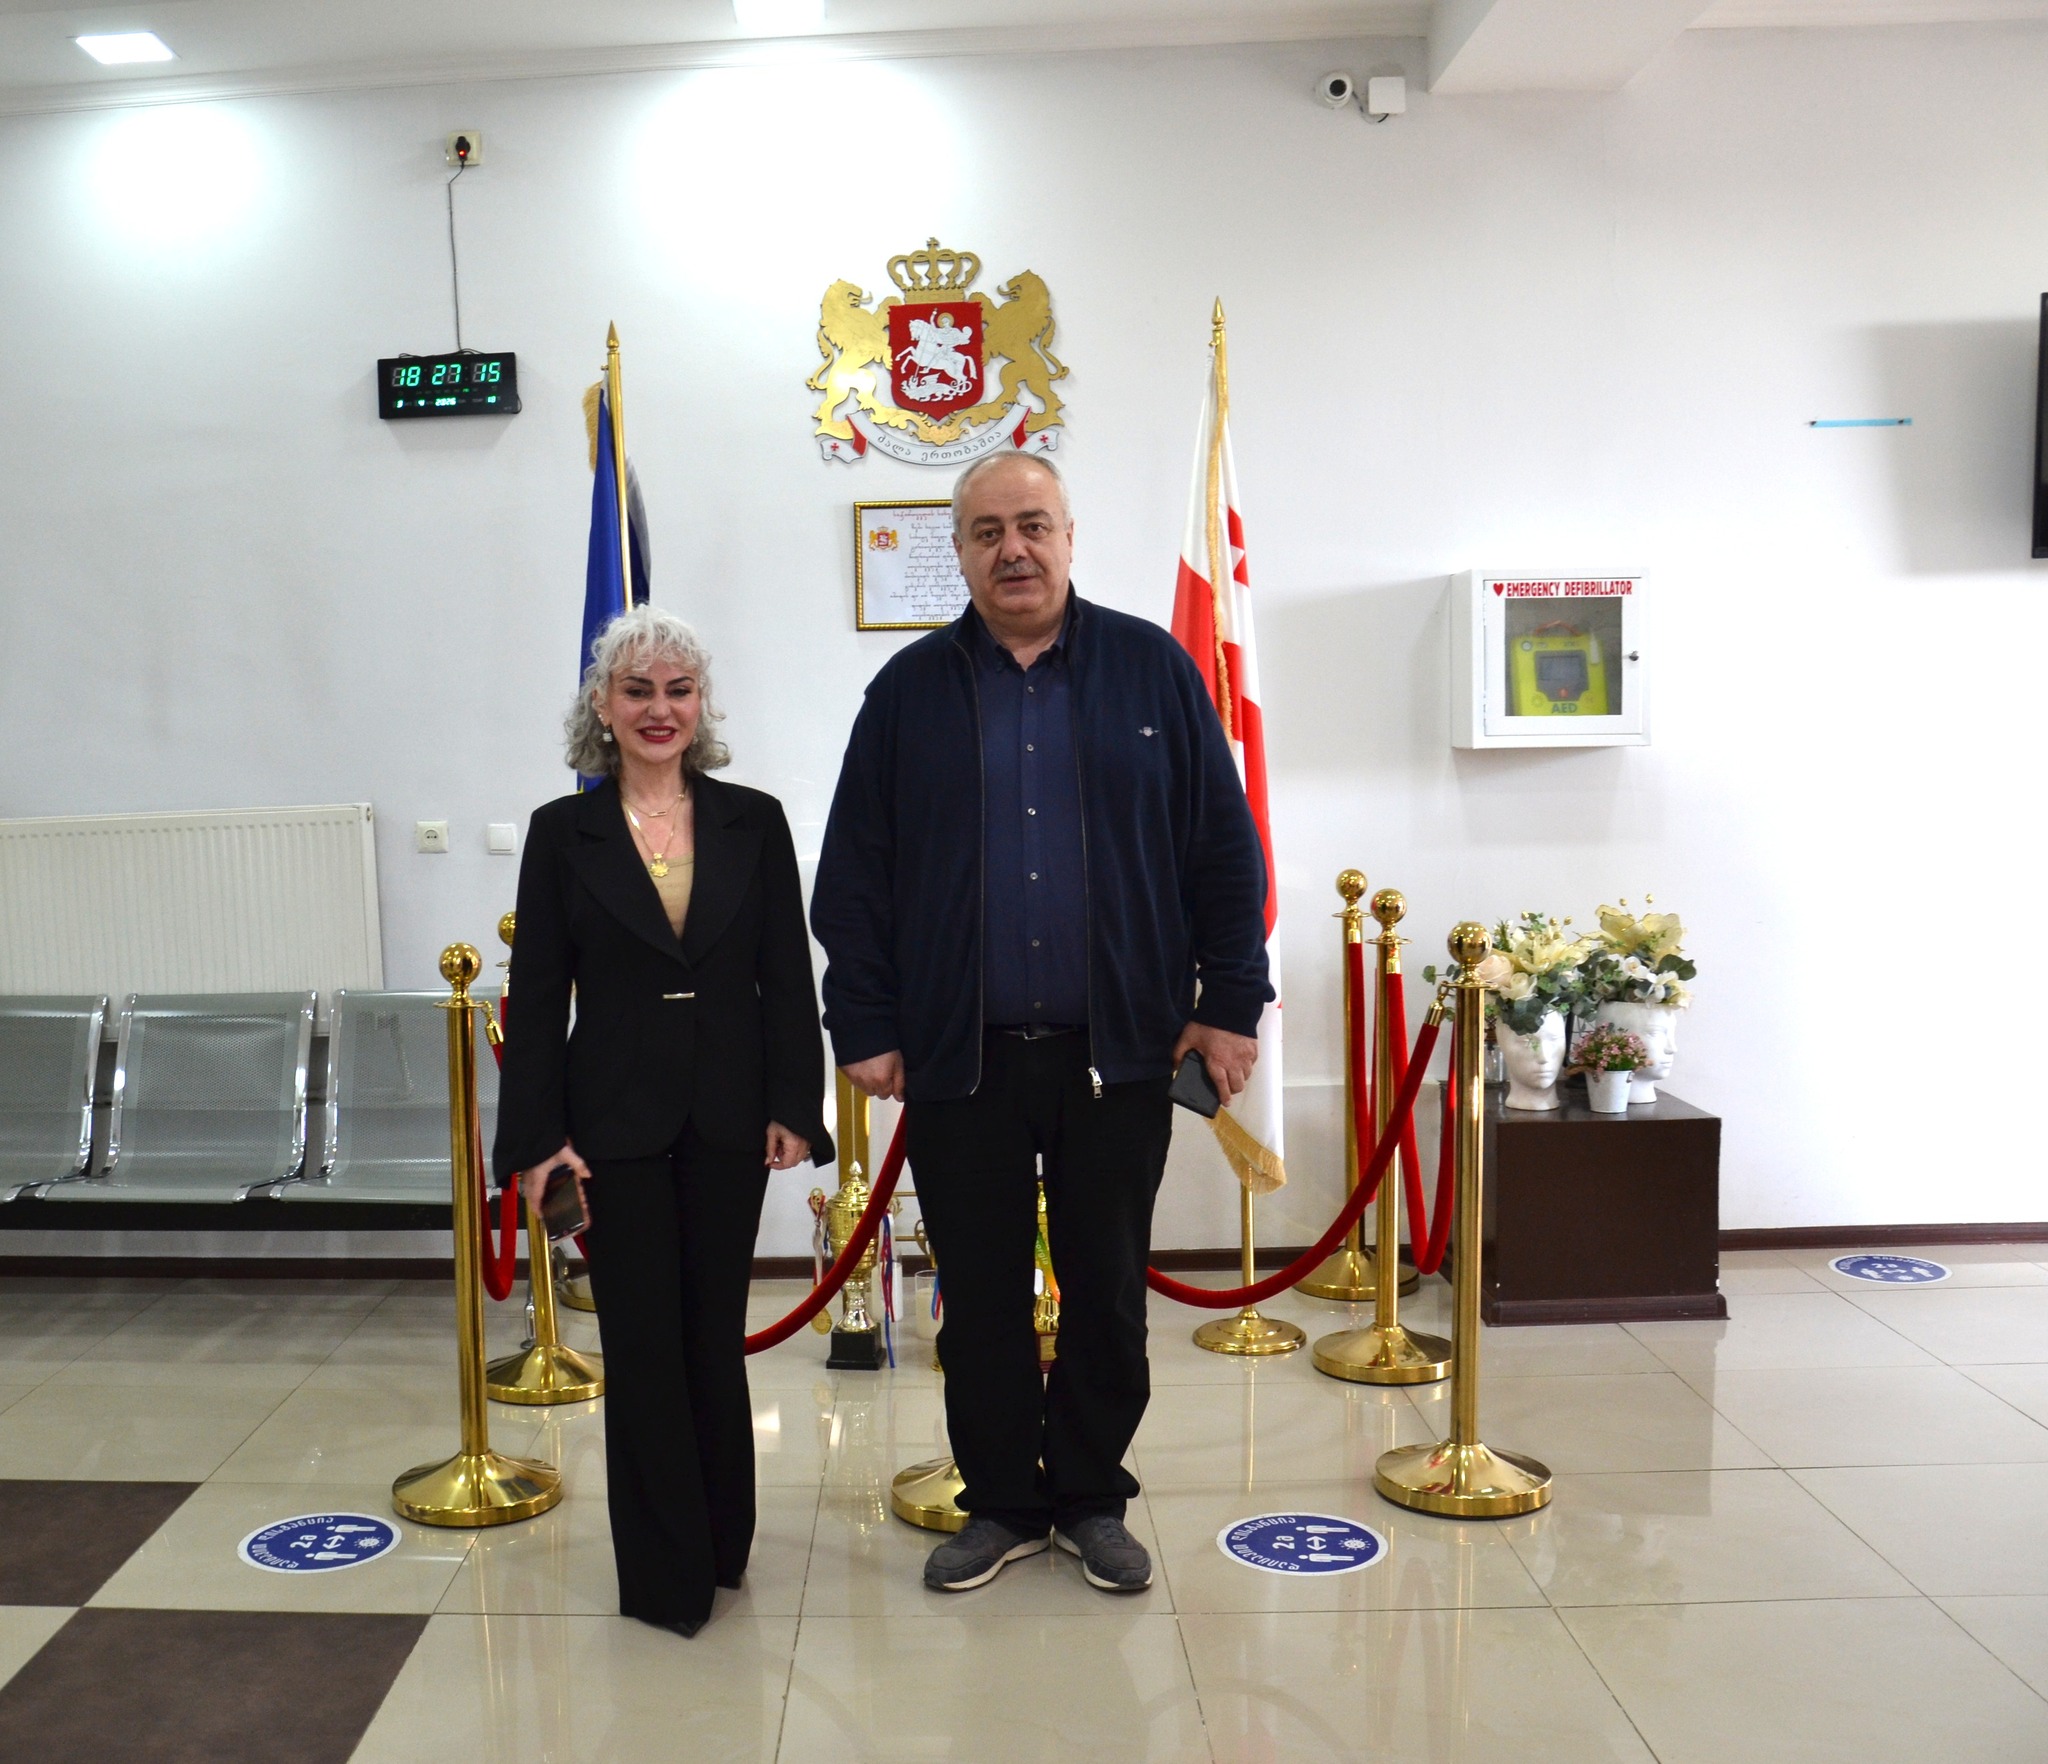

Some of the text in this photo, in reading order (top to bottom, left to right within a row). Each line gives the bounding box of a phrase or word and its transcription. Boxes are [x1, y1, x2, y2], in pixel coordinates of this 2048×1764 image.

[399, 362, 501, 387] 18 27 15
[877, 431, 1002, 462] ძალა ერთობაშია
[1506, 580, 1633, 597] EMERGENCY DEFIBRILLATOR
[1551, 702, 1578, 714] AED
[1232, 1543, 1300, 1571] დაიცავით
